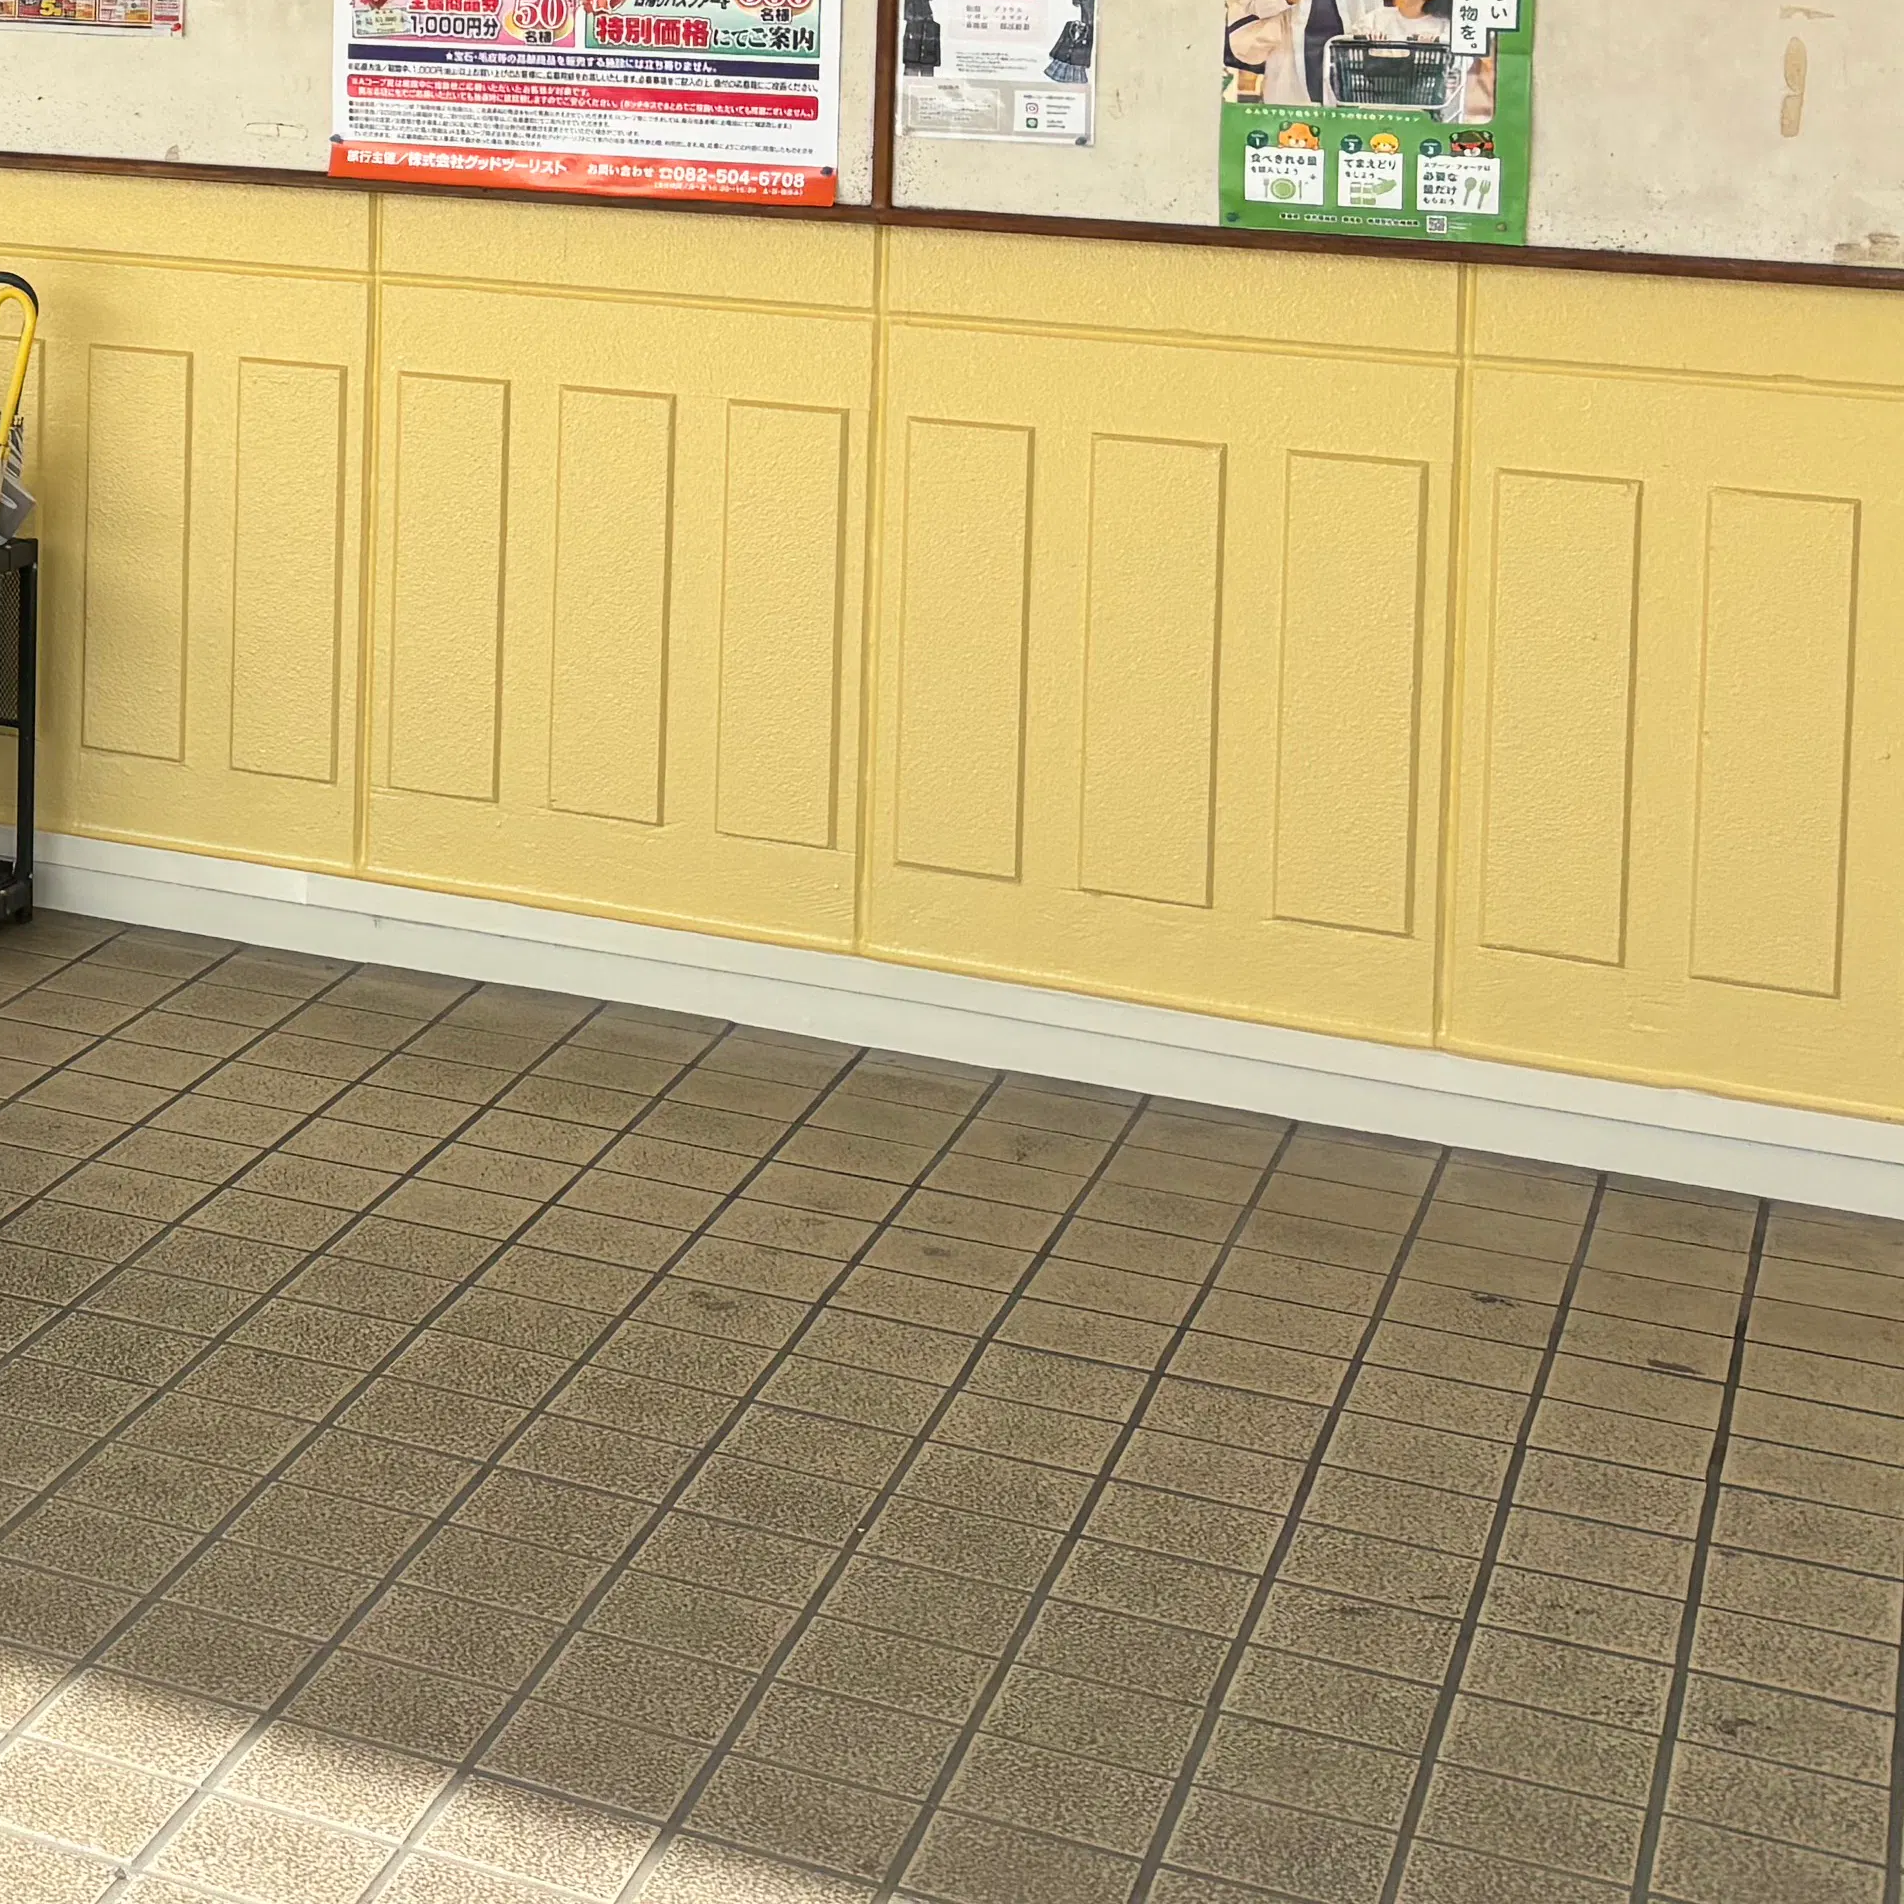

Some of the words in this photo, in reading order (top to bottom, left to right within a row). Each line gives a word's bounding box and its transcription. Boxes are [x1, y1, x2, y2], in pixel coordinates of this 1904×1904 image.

[410, 16, 499, 38] 1,000円分
[595, 15, 710, 47] 特別価格
[713, 26, 815, 51] にてご案内
[587, 163, 655, 177] お問い合わせ
[1344, 158, 1396, 170] てまえどり
